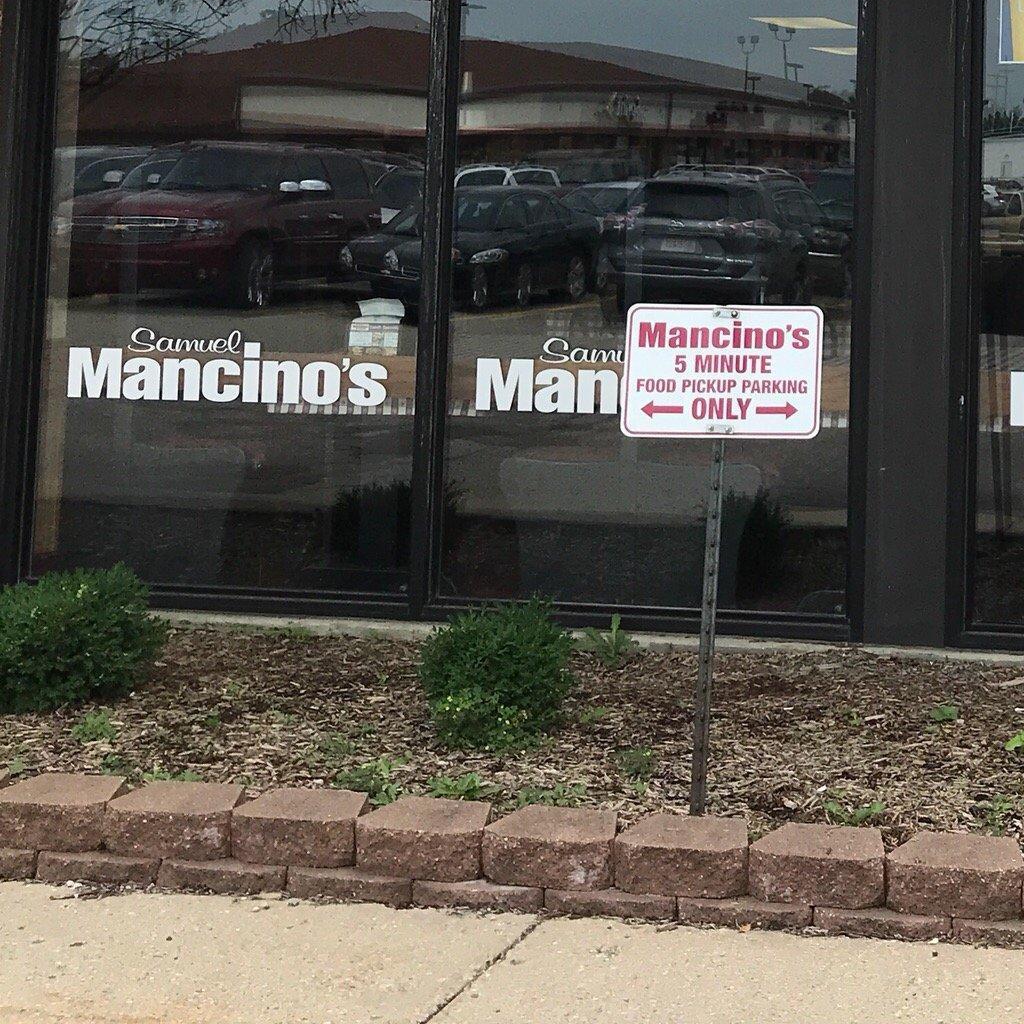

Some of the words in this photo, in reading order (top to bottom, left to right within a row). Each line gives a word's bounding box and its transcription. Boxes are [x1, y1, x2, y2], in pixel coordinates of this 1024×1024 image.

[127, 327, 242, 354] Samuel
[638, 320, 810, 350] Mancino's
[66, 342, 388, 407] Mancino's
[674, 354, 687, 374] 5
[694, 354, 772, 374] MINUTE
[636, 379, 676, 393] FOOD
[682, 379, 736, 394] PICKUP
[742, 380, 808, 394] PARKING
[691, 397, 752, 421] ONLY
